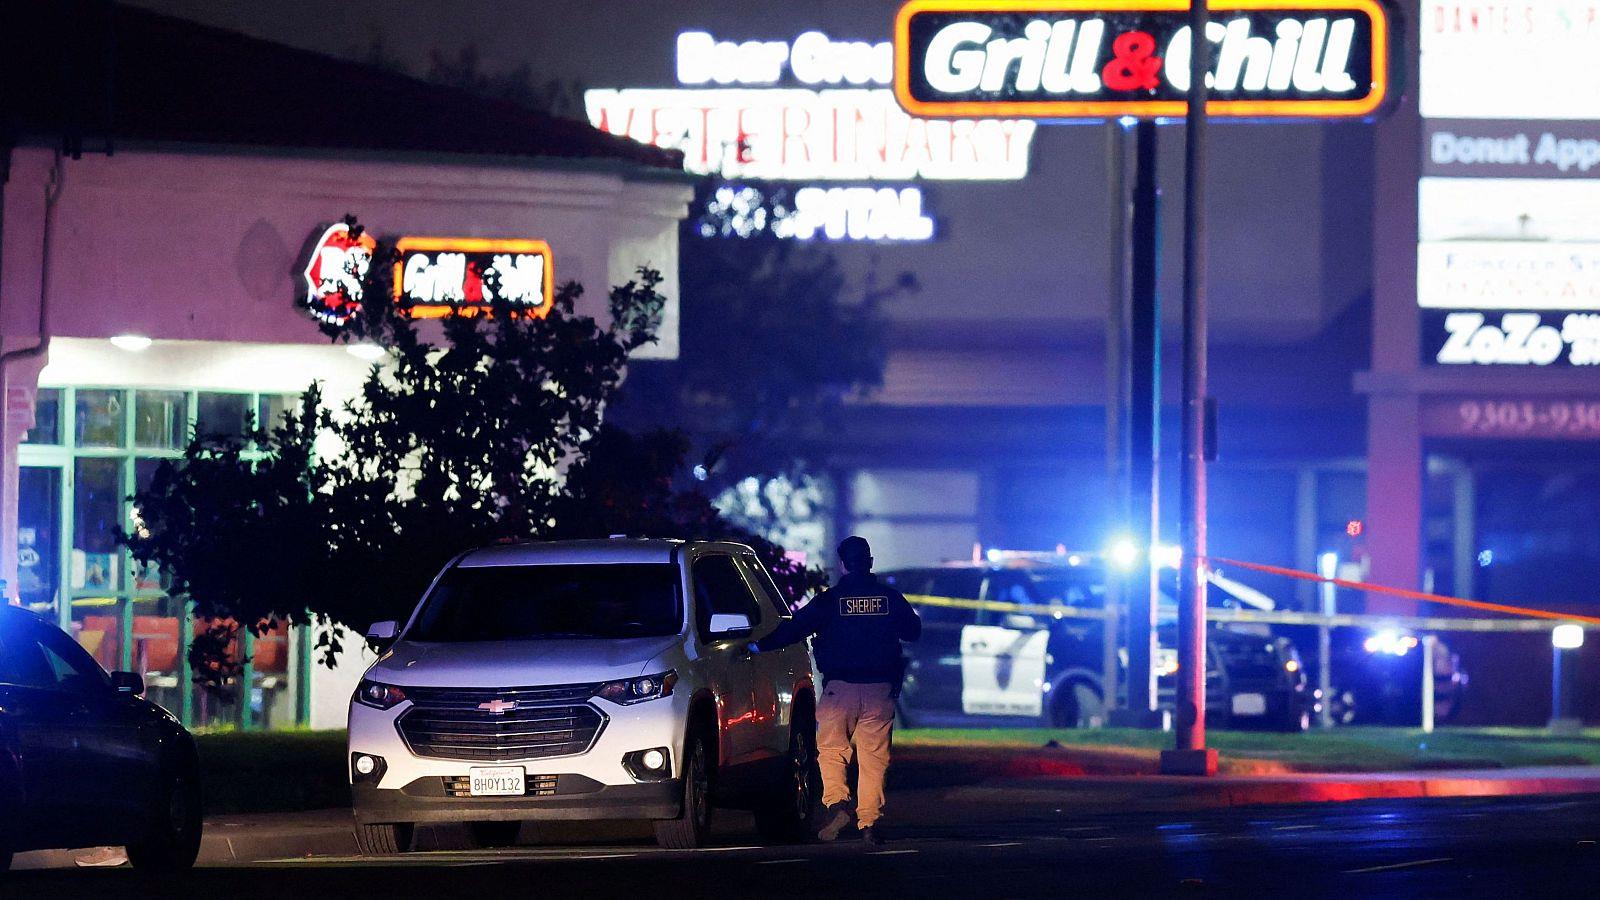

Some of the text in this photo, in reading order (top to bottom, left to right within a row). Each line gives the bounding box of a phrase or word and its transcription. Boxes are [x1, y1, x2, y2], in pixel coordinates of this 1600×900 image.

[677, 31, 789, 84] Bear
[585, 90, 1036, 179] VETERINARY
[1431, 132, 1530, 164] Donut
[702, 187, 933, 239] PITAL
[1436, 312, 1563, 365] ZoZo
[846, 598, 882, 614] SHERIFF
